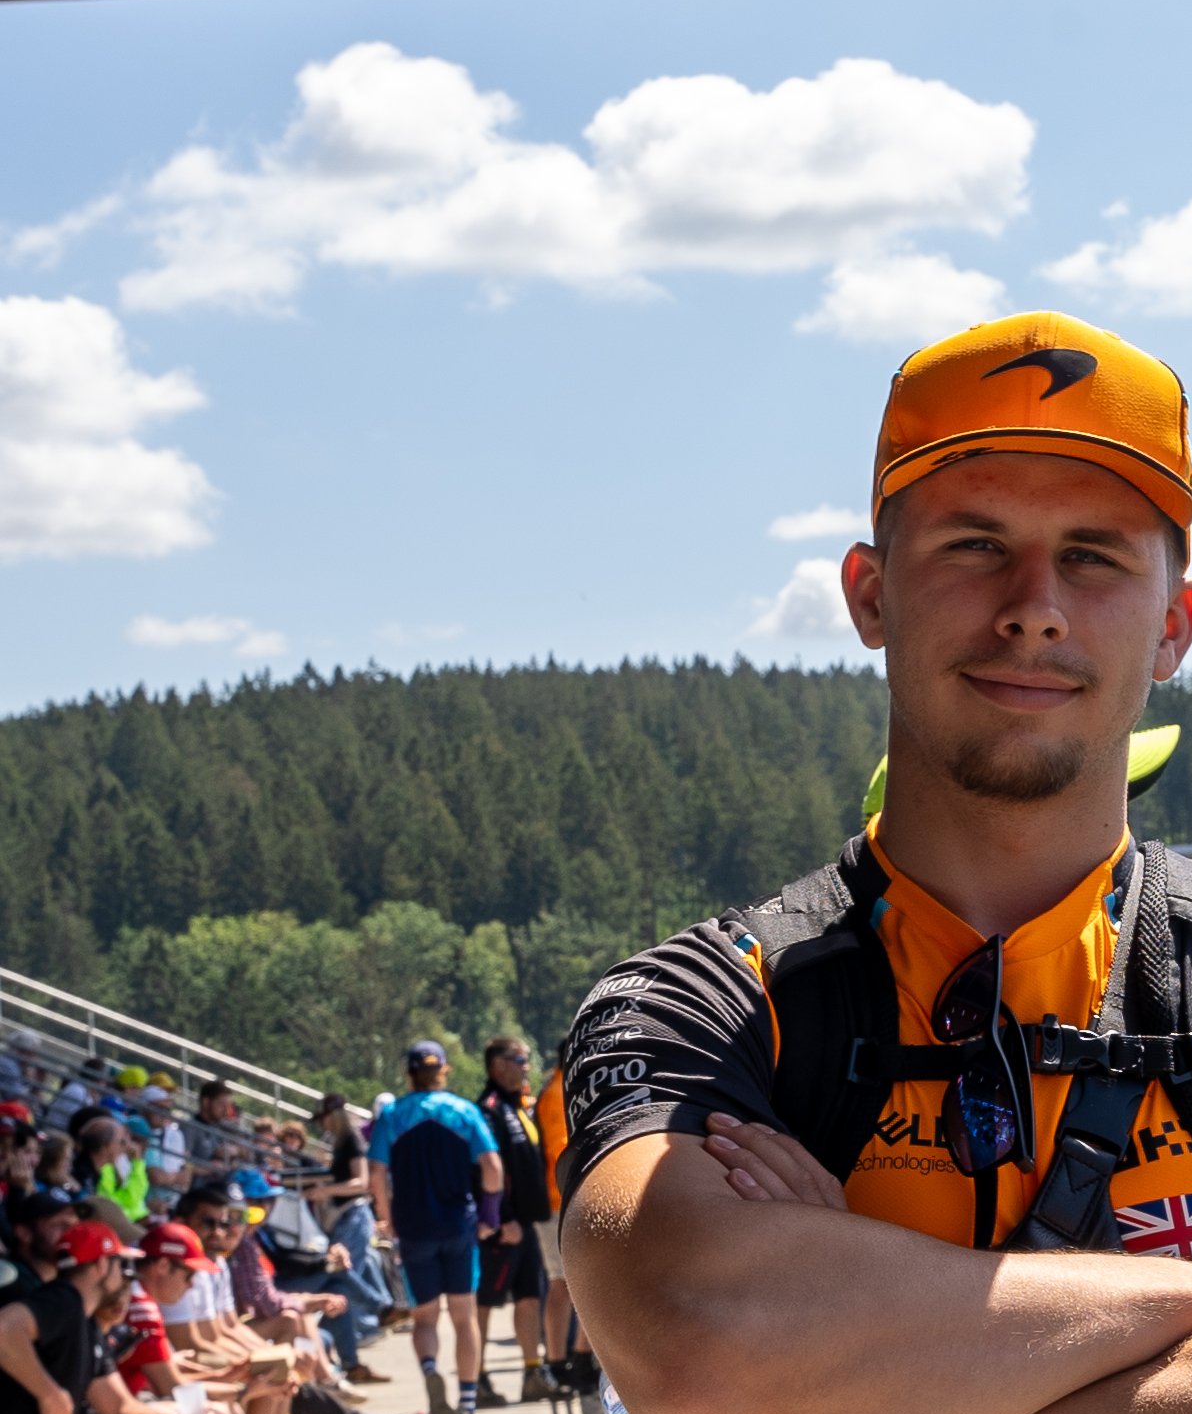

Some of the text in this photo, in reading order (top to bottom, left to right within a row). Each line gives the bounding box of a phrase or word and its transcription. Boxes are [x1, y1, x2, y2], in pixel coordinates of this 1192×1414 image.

[568, 1058, 647, 1137] FxPro
[876, 1111, 951, 1148] ELL
[853, 1152, 957, 1176] echnologies
